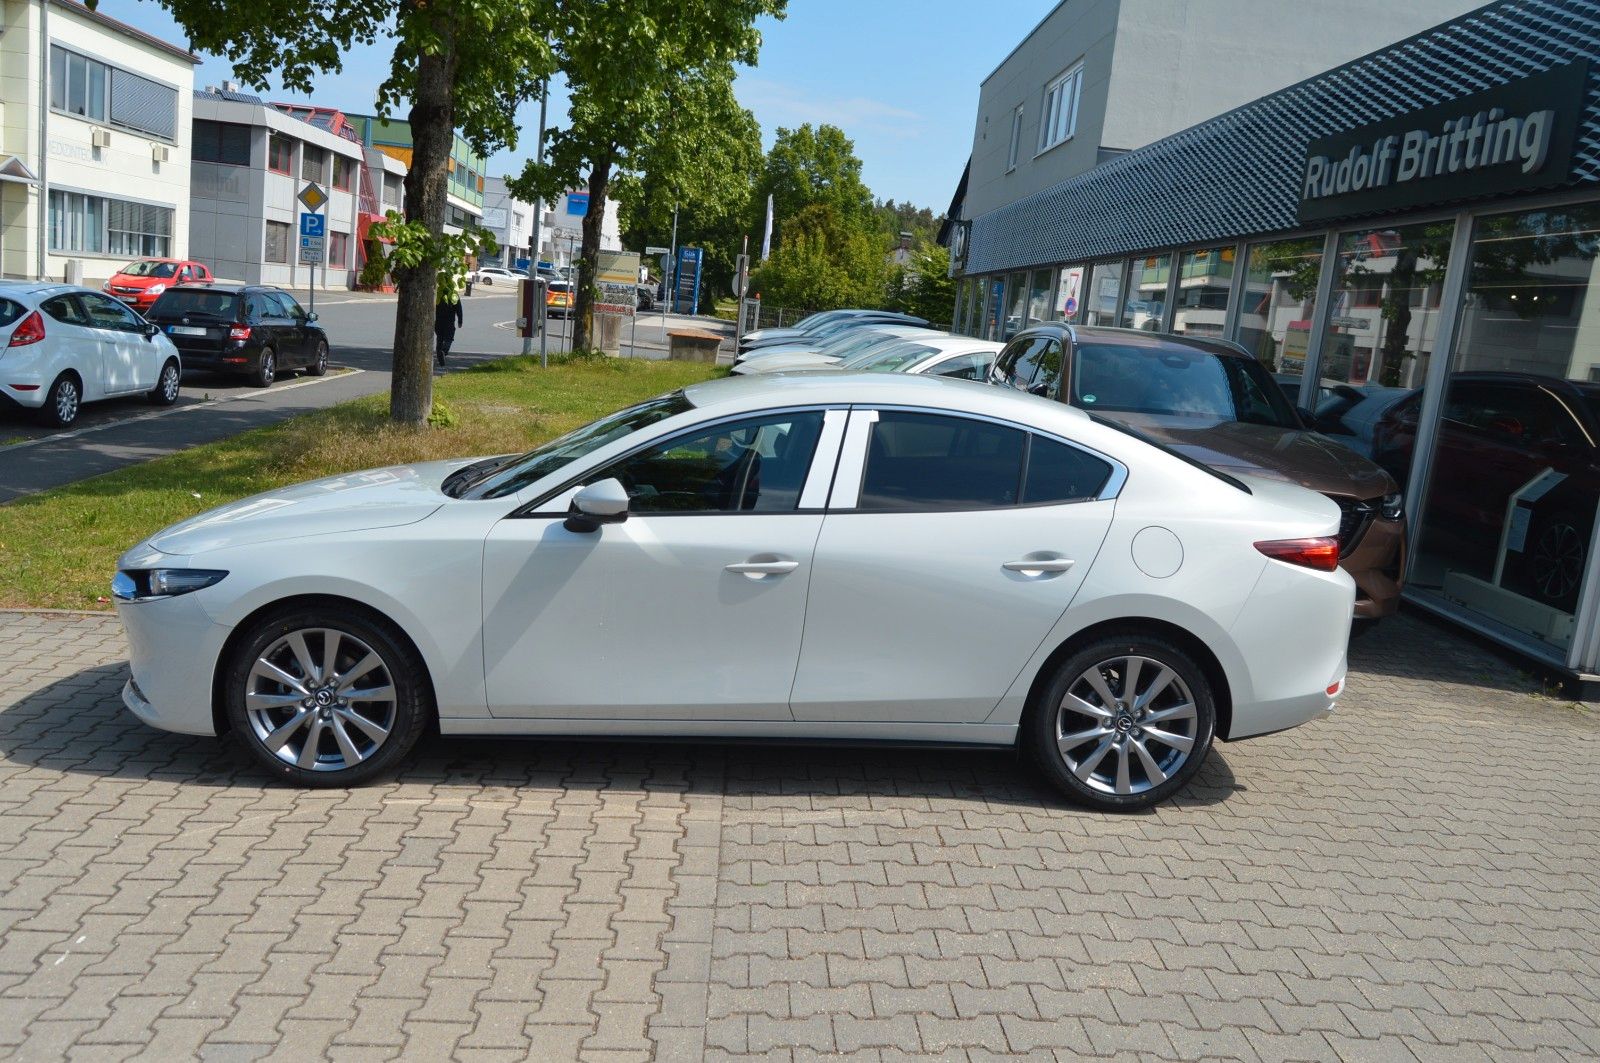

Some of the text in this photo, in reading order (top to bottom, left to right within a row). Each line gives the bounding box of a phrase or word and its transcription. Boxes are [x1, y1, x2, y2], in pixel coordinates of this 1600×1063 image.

[1303, 108, 1554, 200] Rudolf Britting
[306, 215, 319, 233] P
